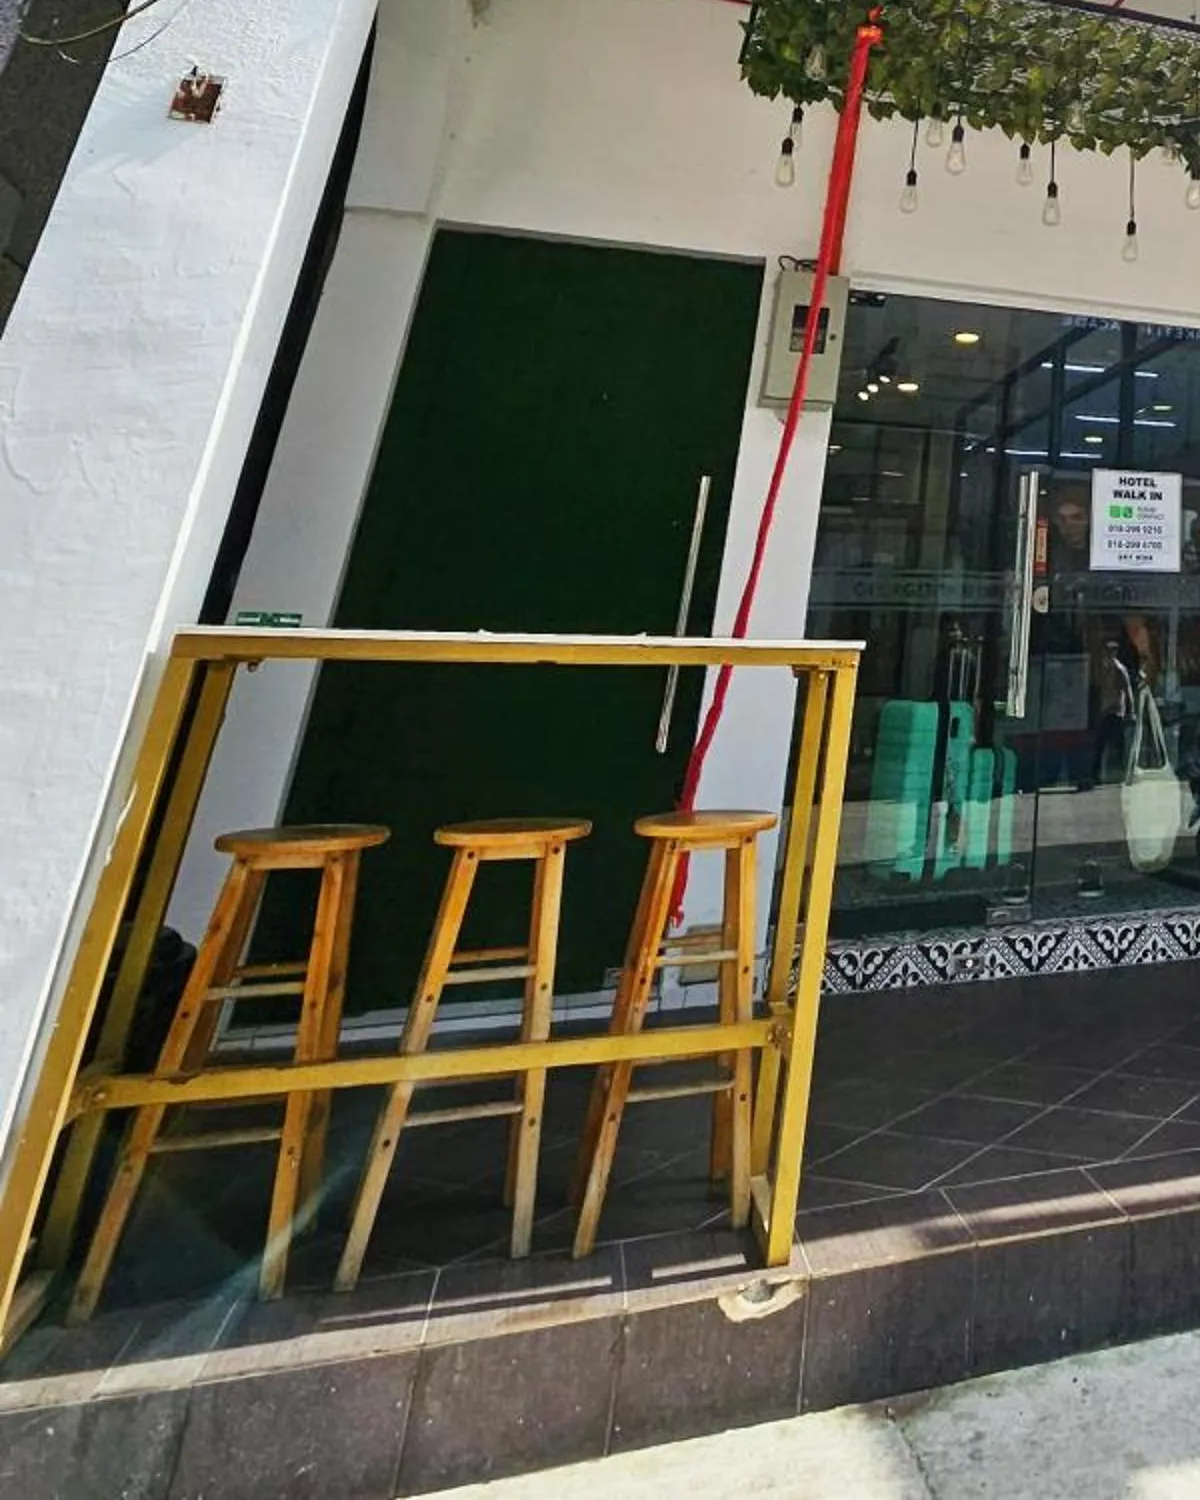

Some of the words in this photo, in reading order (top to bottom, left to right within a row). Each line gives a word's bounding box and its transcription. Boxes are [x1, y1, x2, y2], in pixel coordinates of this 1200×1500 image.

[1119, 476, 1157, 487] HOTEL
[1112, 489, 1147, 501] WALK
[1150, 491, 1163, 501] IN
